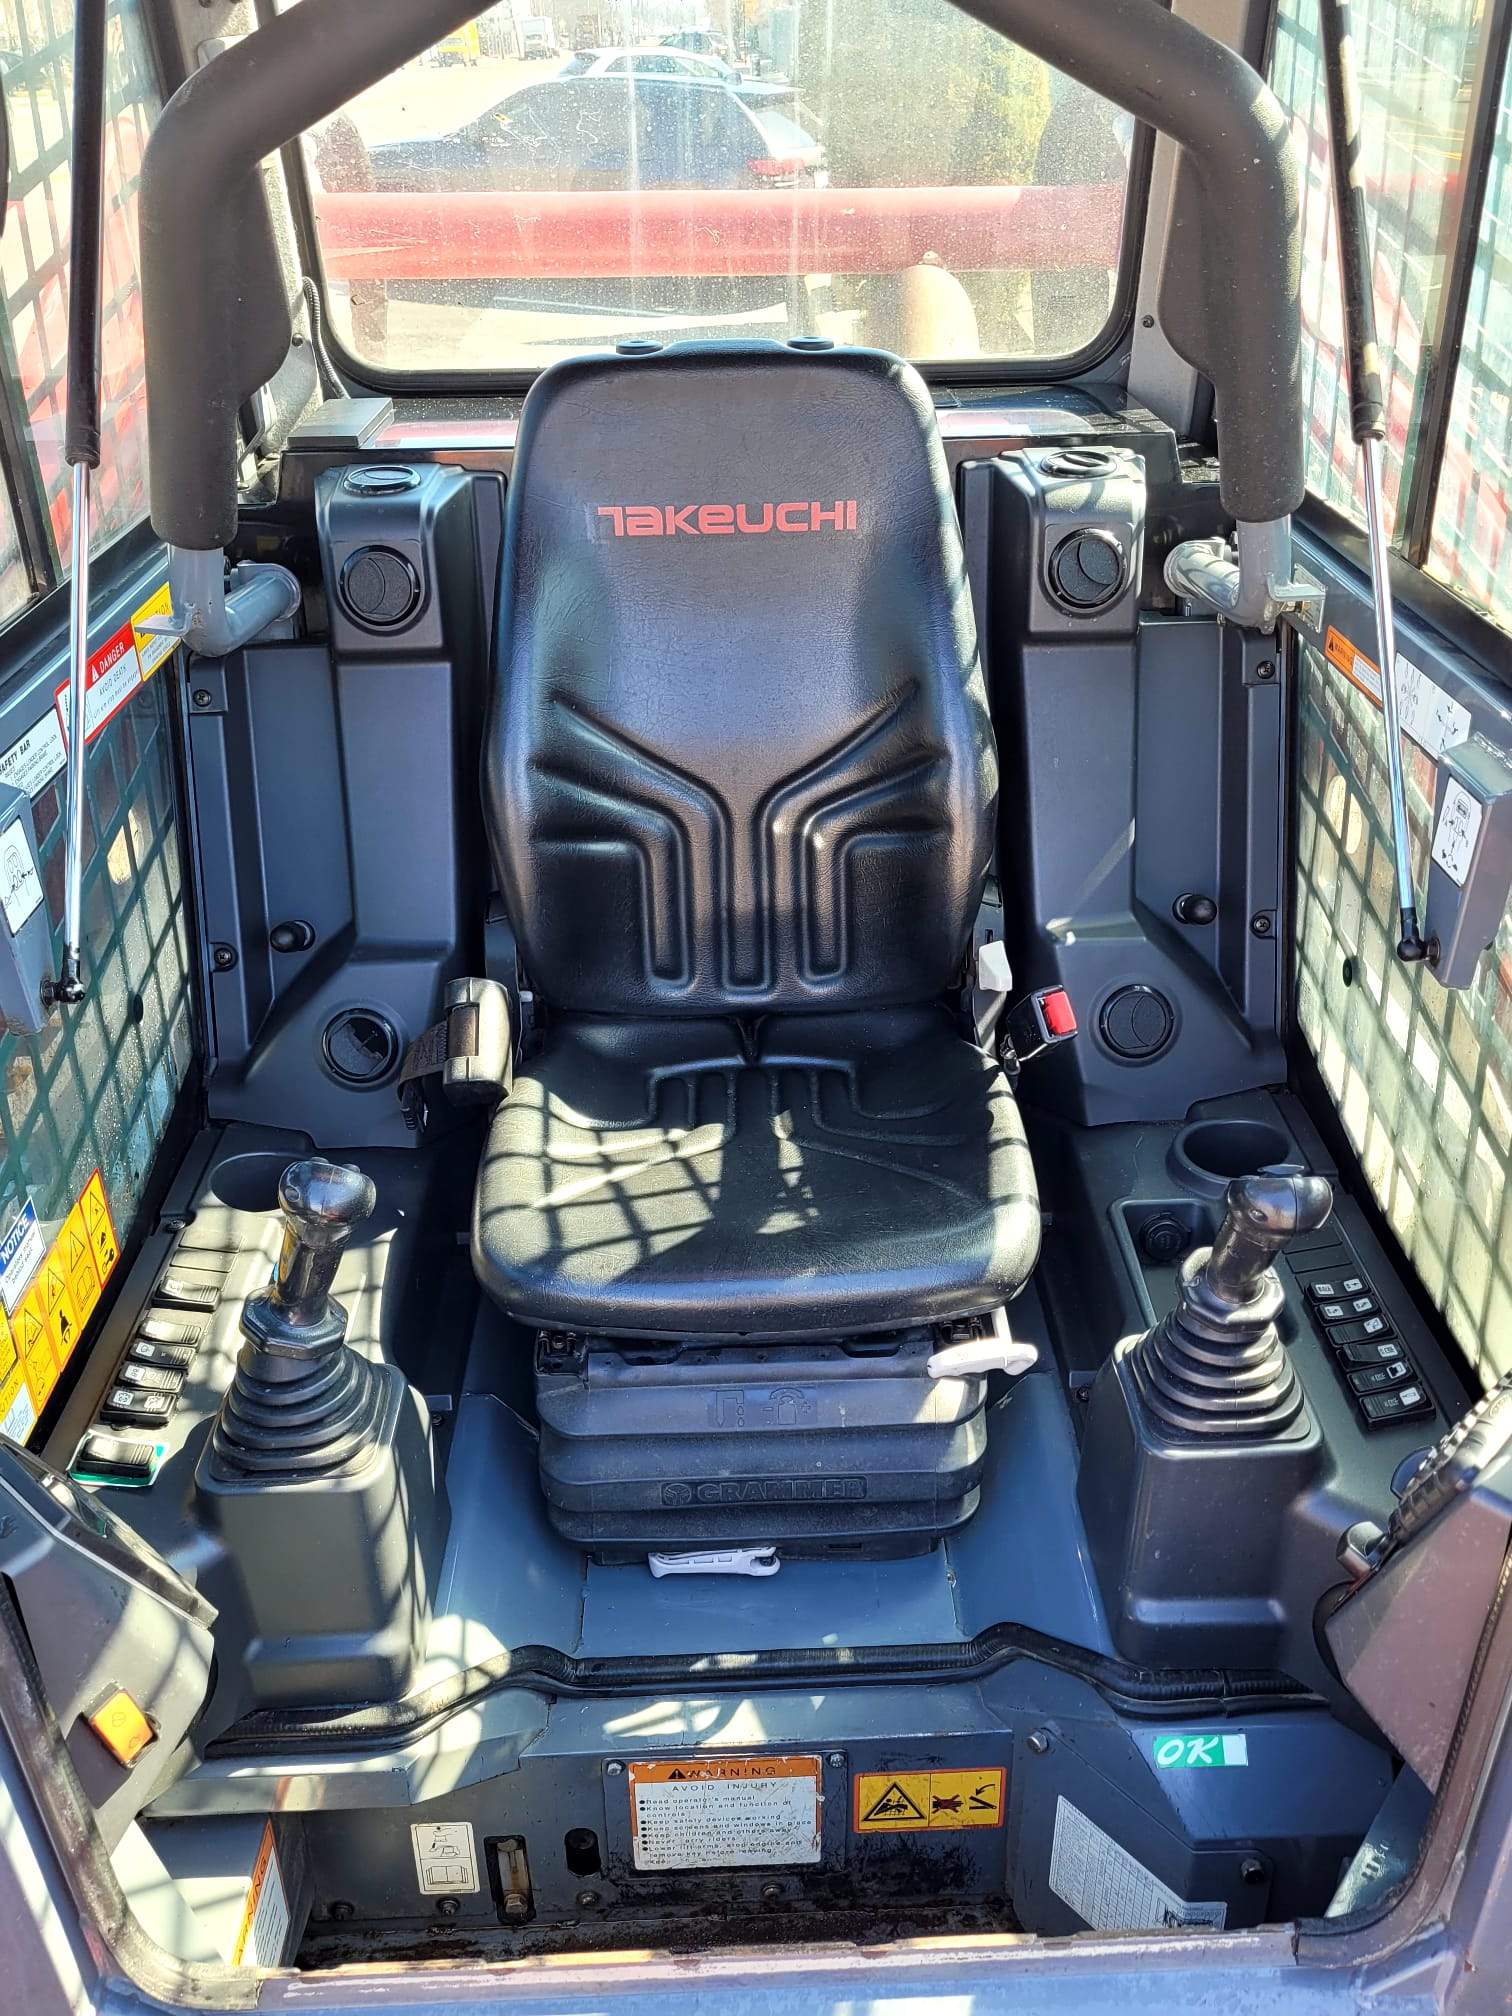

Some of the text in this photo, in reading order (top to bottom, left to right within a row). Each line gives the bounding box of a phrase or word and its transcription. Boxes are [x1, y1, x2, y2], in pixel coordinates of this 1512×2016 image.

[99, 642, 125, 674] DANGER
[20, 739, 31, 756] BAR
[1, 1213, 30, 1264] NOTICE
[697, 1478, 866, 1502] GRAMMER
[1157, 1737, 1219, 1765] OK
[688, 1766, 777, 1778] WARNING
[727, 1780, 777, 1790] INJURY
